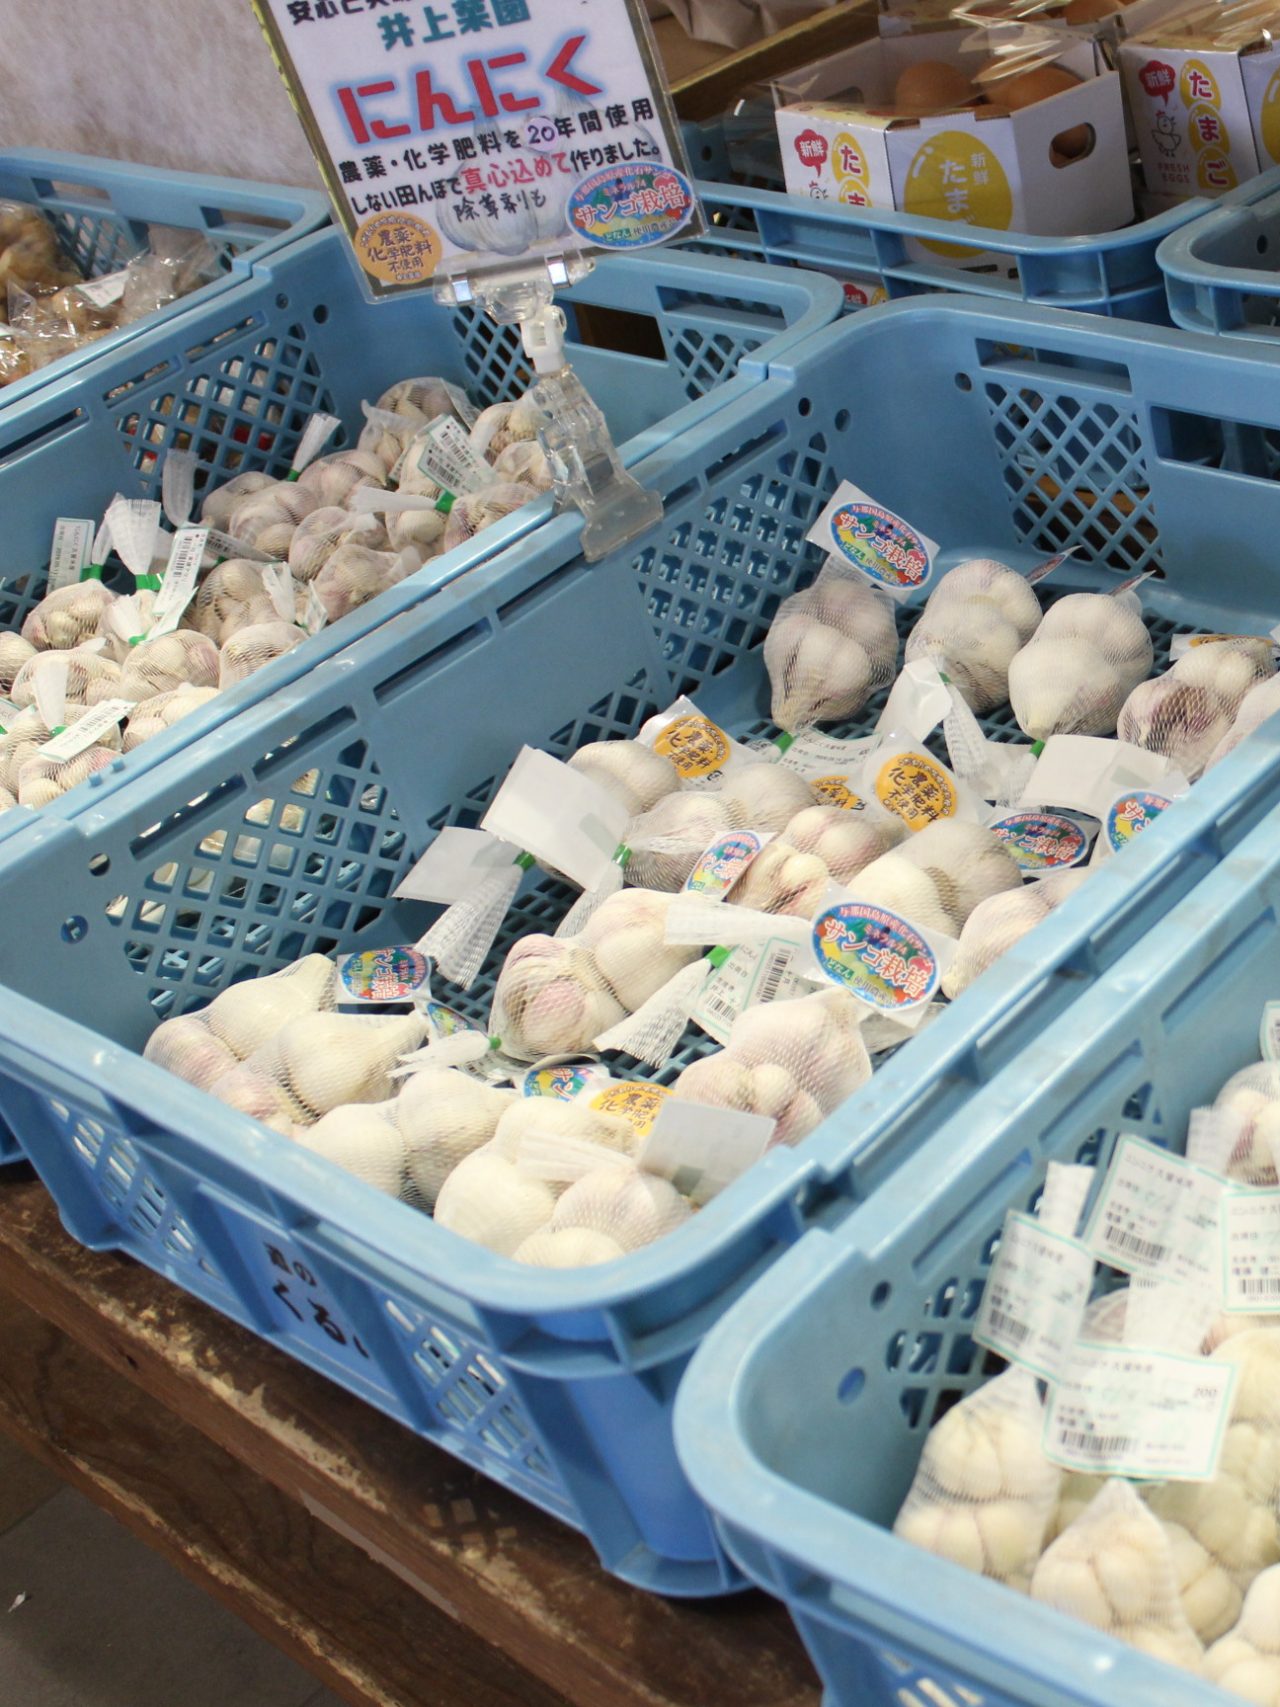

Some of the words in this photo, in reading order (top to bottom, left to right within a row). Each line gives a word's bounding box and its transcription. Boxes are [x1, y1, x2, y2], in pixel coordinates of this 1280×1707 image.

[337, 35, 603, 144] にんにく
[1189, 71, 1227, 186] たまご
[574, 184, 686, 228] サンゴ栽培
[839, 511, 925, 582] サンゴ栽培
[824, 918, 929, 998] サンゴ栽培
